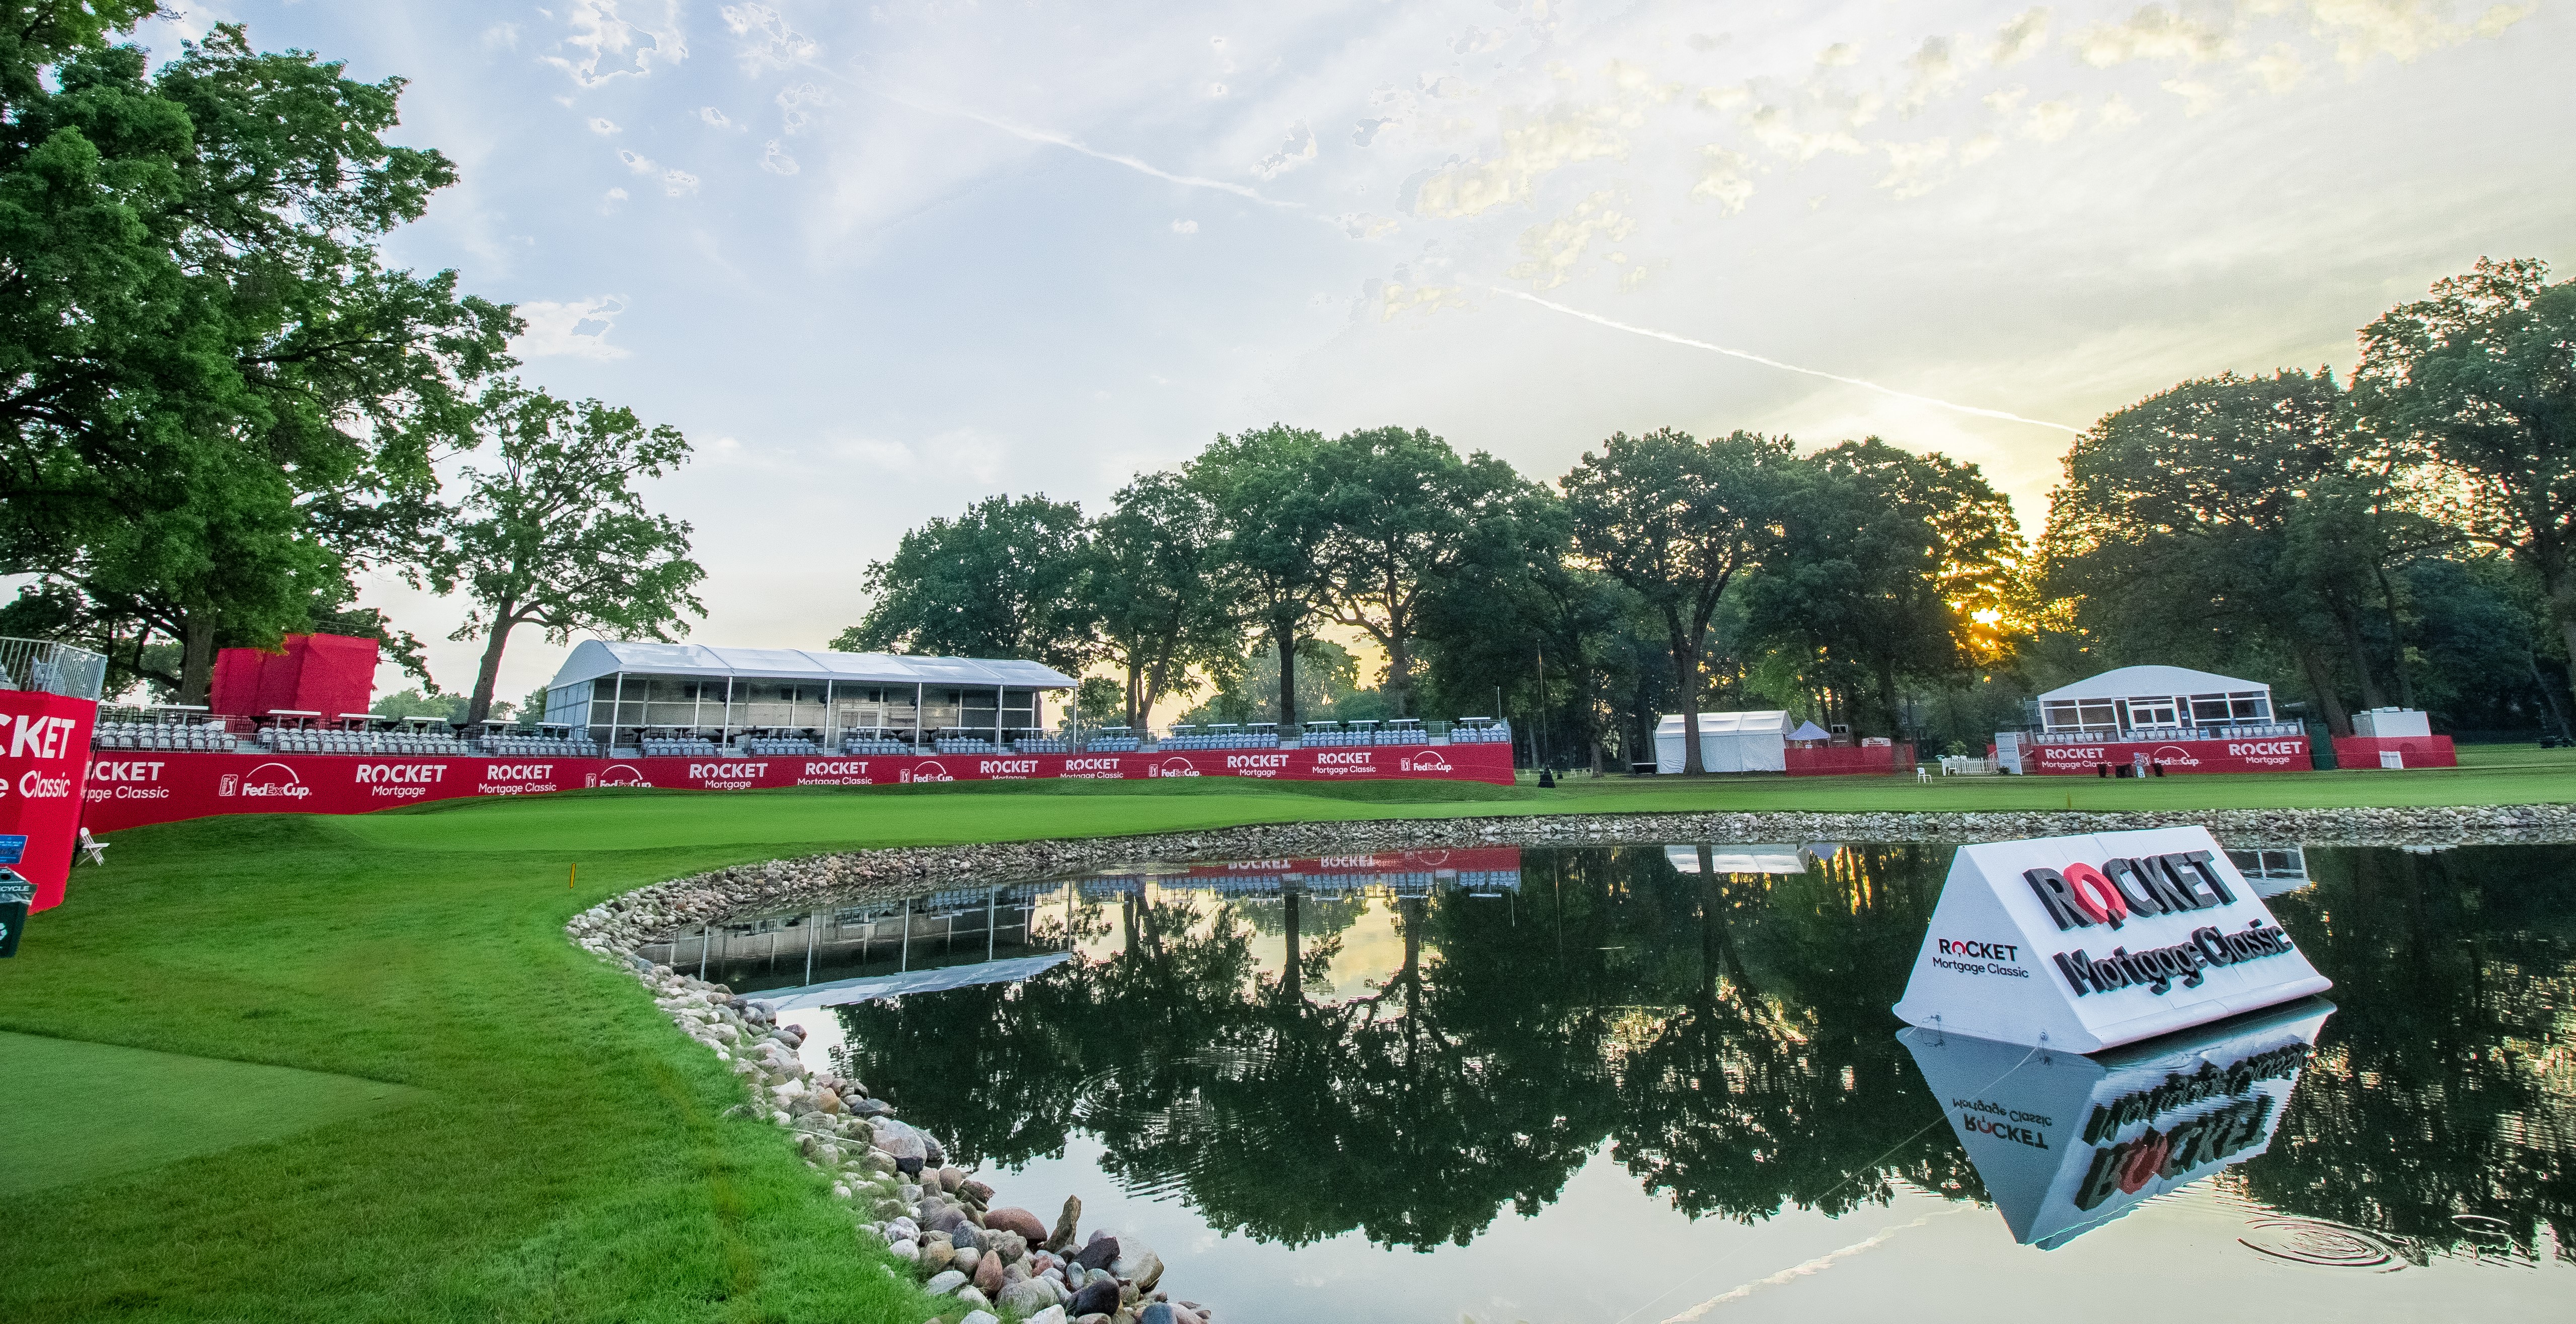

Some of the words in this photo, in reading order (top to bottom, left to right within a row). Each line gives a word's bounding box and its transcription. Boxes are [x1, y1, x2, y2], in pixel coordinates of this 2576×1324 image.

[0, 713, 75, 759] KET
[2045, 748, 2104, 759] ROCKET
[2229, 742, 2302, 756] ROCKET
[1066, 758, 1119, 771] ROCKET
[1227, 755, 1289, 768] ROCKET
[1318, 753, 1371, 765] ROCKET
[2042, 761, 2080, 769] Mortgage
[2246, 756, 2289, 765] Mortgage
[487, 765, 553, 781] ROCKET
[690, 763, 768, 778] ROCKET
[805, 762, 868, 776] ROCKET
[980, 760, 1038, 773] ROCKET
[1162, 768, 1199, 777] FedExCup
[1240, 769, 1275, 777] Mortgage
[1312, 766, 1348, 775] Mortgage
[1413, 762, 1452, 772] FedExCup
[356, 765, 447, 783] ROCKET
[914, 774, 953, 782] FedExCup
[19, 770, 70, 798] Classic
[705, 780, 751, 790] Mortgage
[842, 777, 872, 785] Classic
[116, 786, 169, 798] Classic
[242, 783, 309, 799] FedExCup
[372, 785, 426, 797] Mortgage
[478, 783, 523, 795] Mortgage
[525, 782, 557, 792] Classic
[2022, 850, 2238, 931] ROCKET
[1938, 938, 2017, 962] ROCKET
[2053, 945, 2208, 997] Mortgage
[2191, 918, 2293, 967] Classic
[1933, 957, 1985, 975] Mortgage
[1987, 963, 2029, 978] Classic
